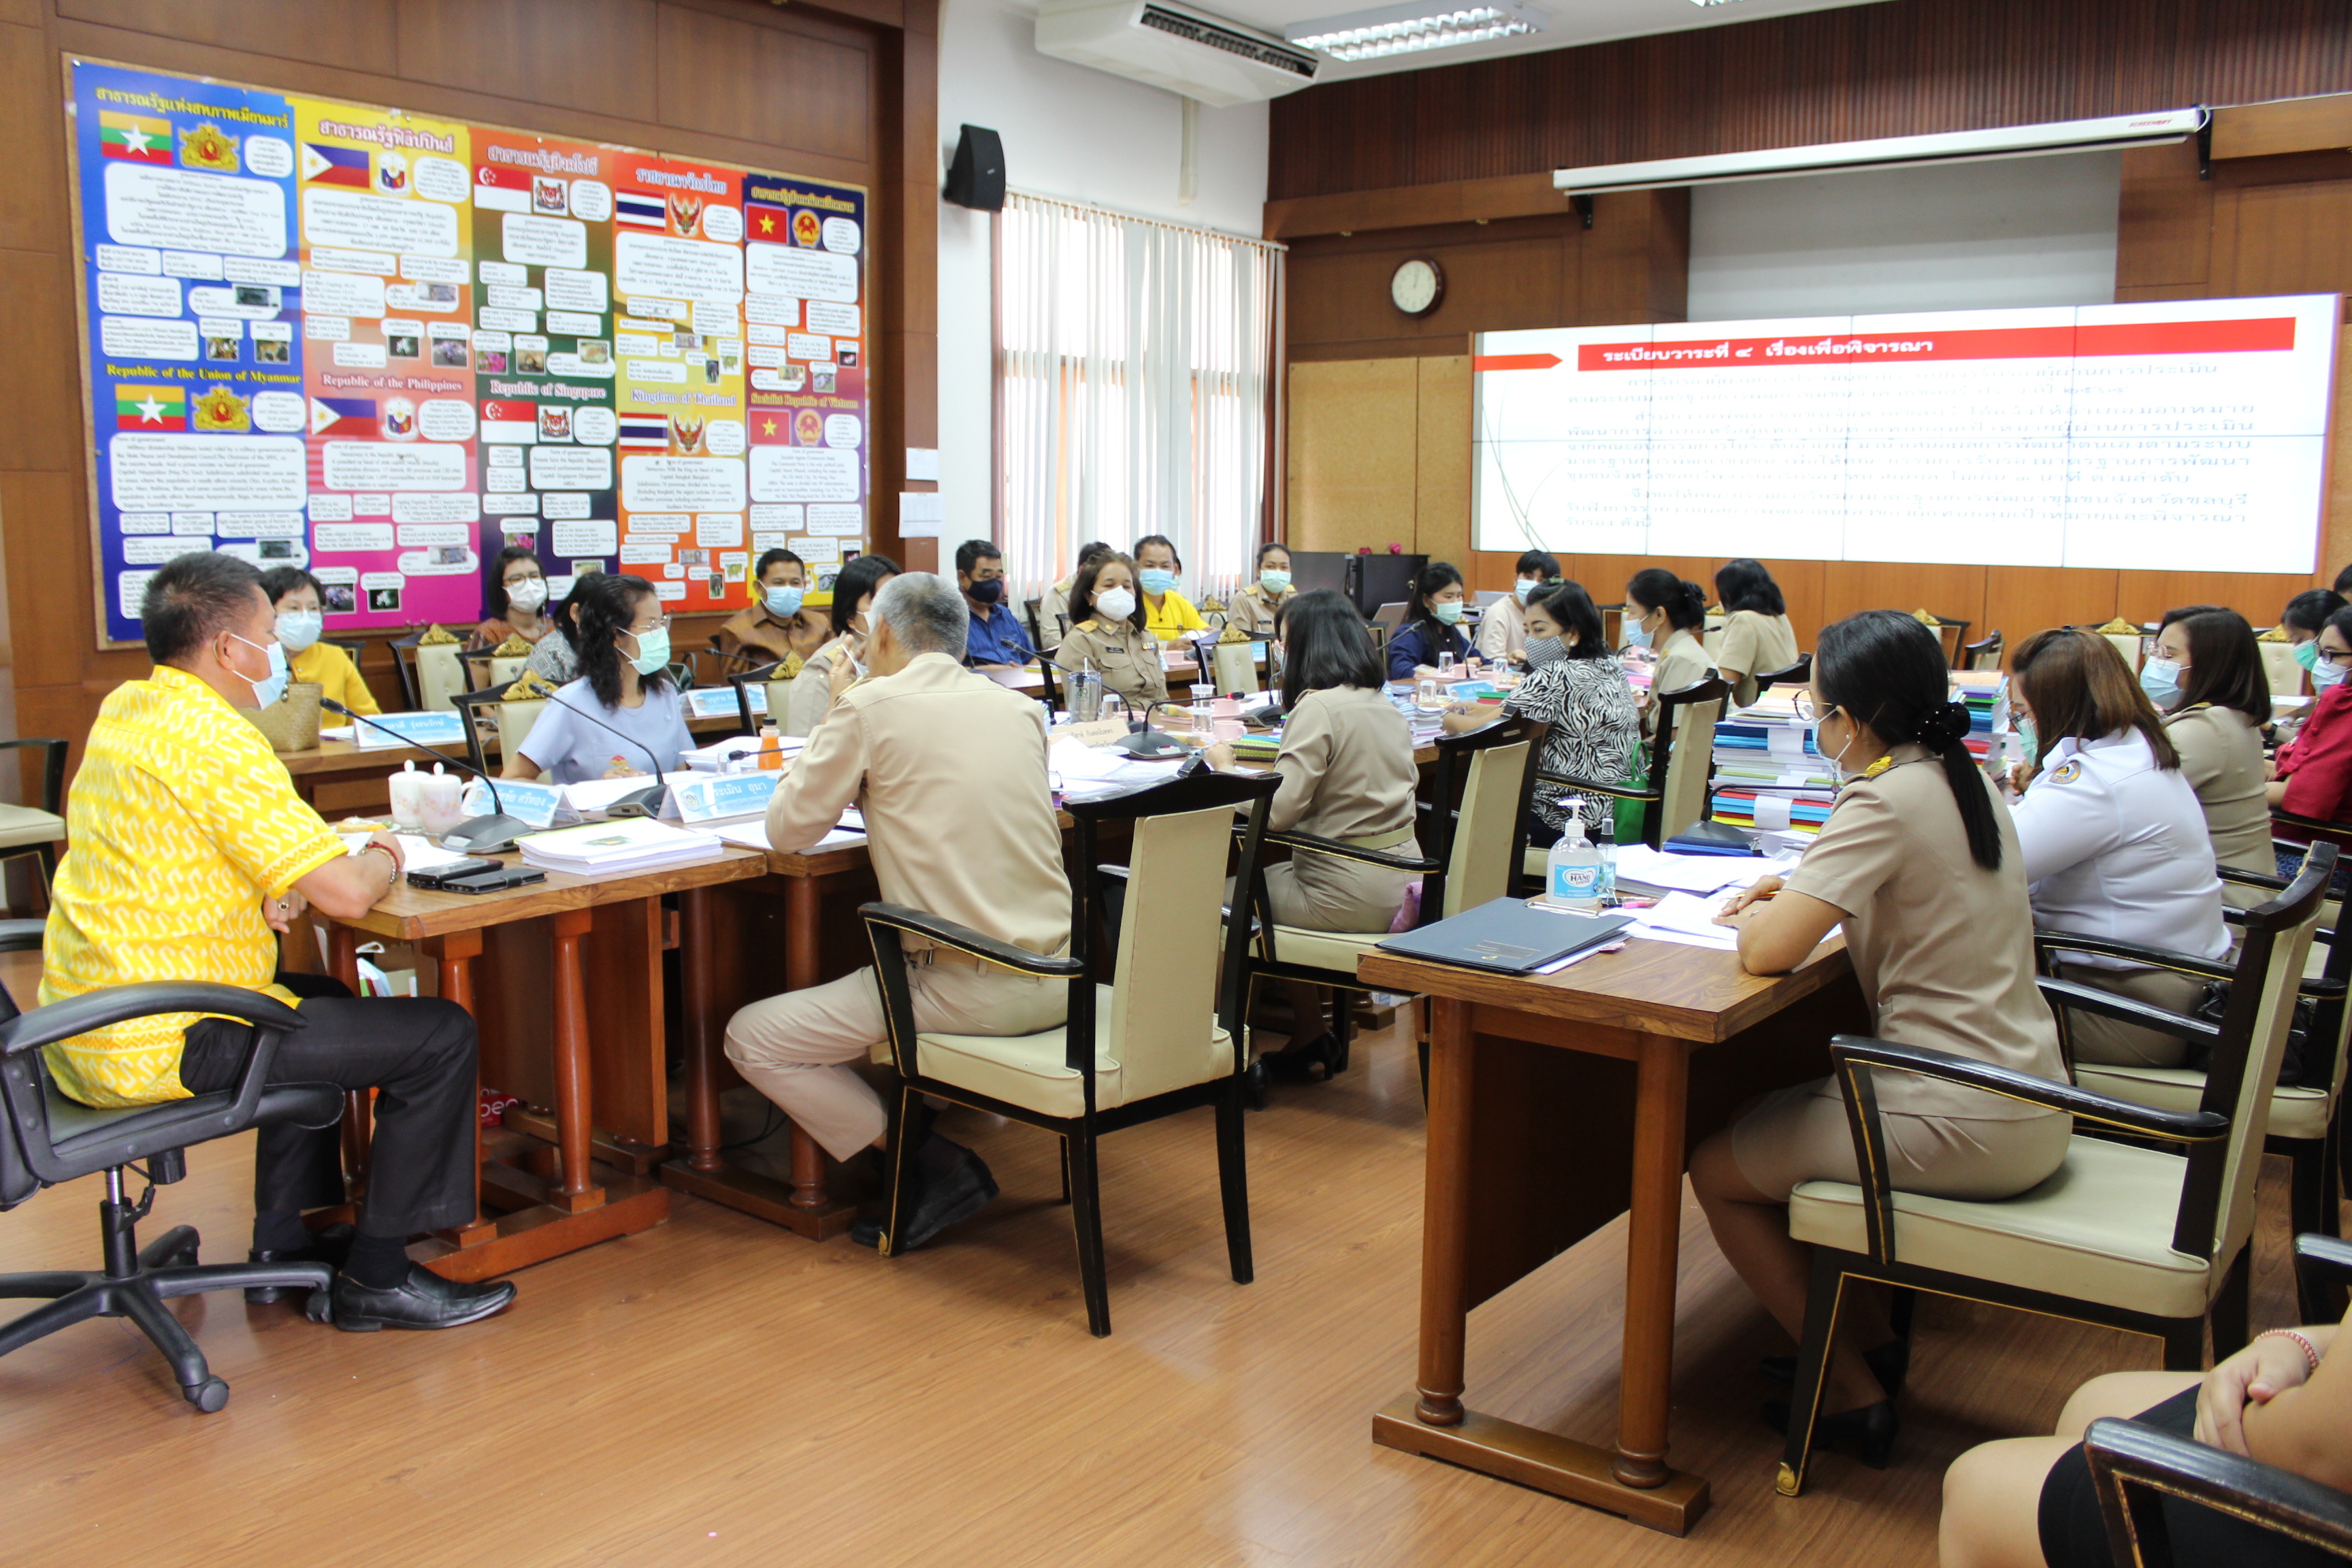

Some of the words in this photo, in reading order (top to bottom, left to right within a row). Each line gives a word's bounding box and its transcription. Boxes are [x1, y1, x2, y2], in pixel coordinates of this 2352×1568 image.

[319, 120, 455, 155] สาธารณรัฐฟิลิปปินส์
[636, 167, 728, 195] ราชอาณาจักรไทย
[1603, 343, 1729, 363] ระเบียบวาระที่
[1736, 347, 1754, 358] ๔
[1766, 337, 1933, 358] เรื่องเพื่อพิจารณา
[106, 363, 162, 380] Republic
[165, 368, 175, 378] of
[177, 368, 195, 379] the
[199, 368, 233, 381] Union
[236, 370, 247, 381] of
[250, 372, 301, 385] Myanmar
[323, 374, 371, 389] Republic
[374, 376, 385, 388] of
[388, 378, 404, 389] the
[407, 378, 462, 392] Philippines
[490, 381, 538, 397] Republic
[540, 382, 552, 396] of
[555, 384, 606, 400] Singapore
[630, 389, 676, 404] Kingdom
[679, 391, 690, 404] of
[693, 392, 736, 407] Thailand
[751, 393, 782, 406] Socialist
[785, 395, 815, 408] Republic
[817, 397, 827, 408] of
[828, 397, 858, 409] Vietnam
[714, 783, 742, 797] ระเมิน
